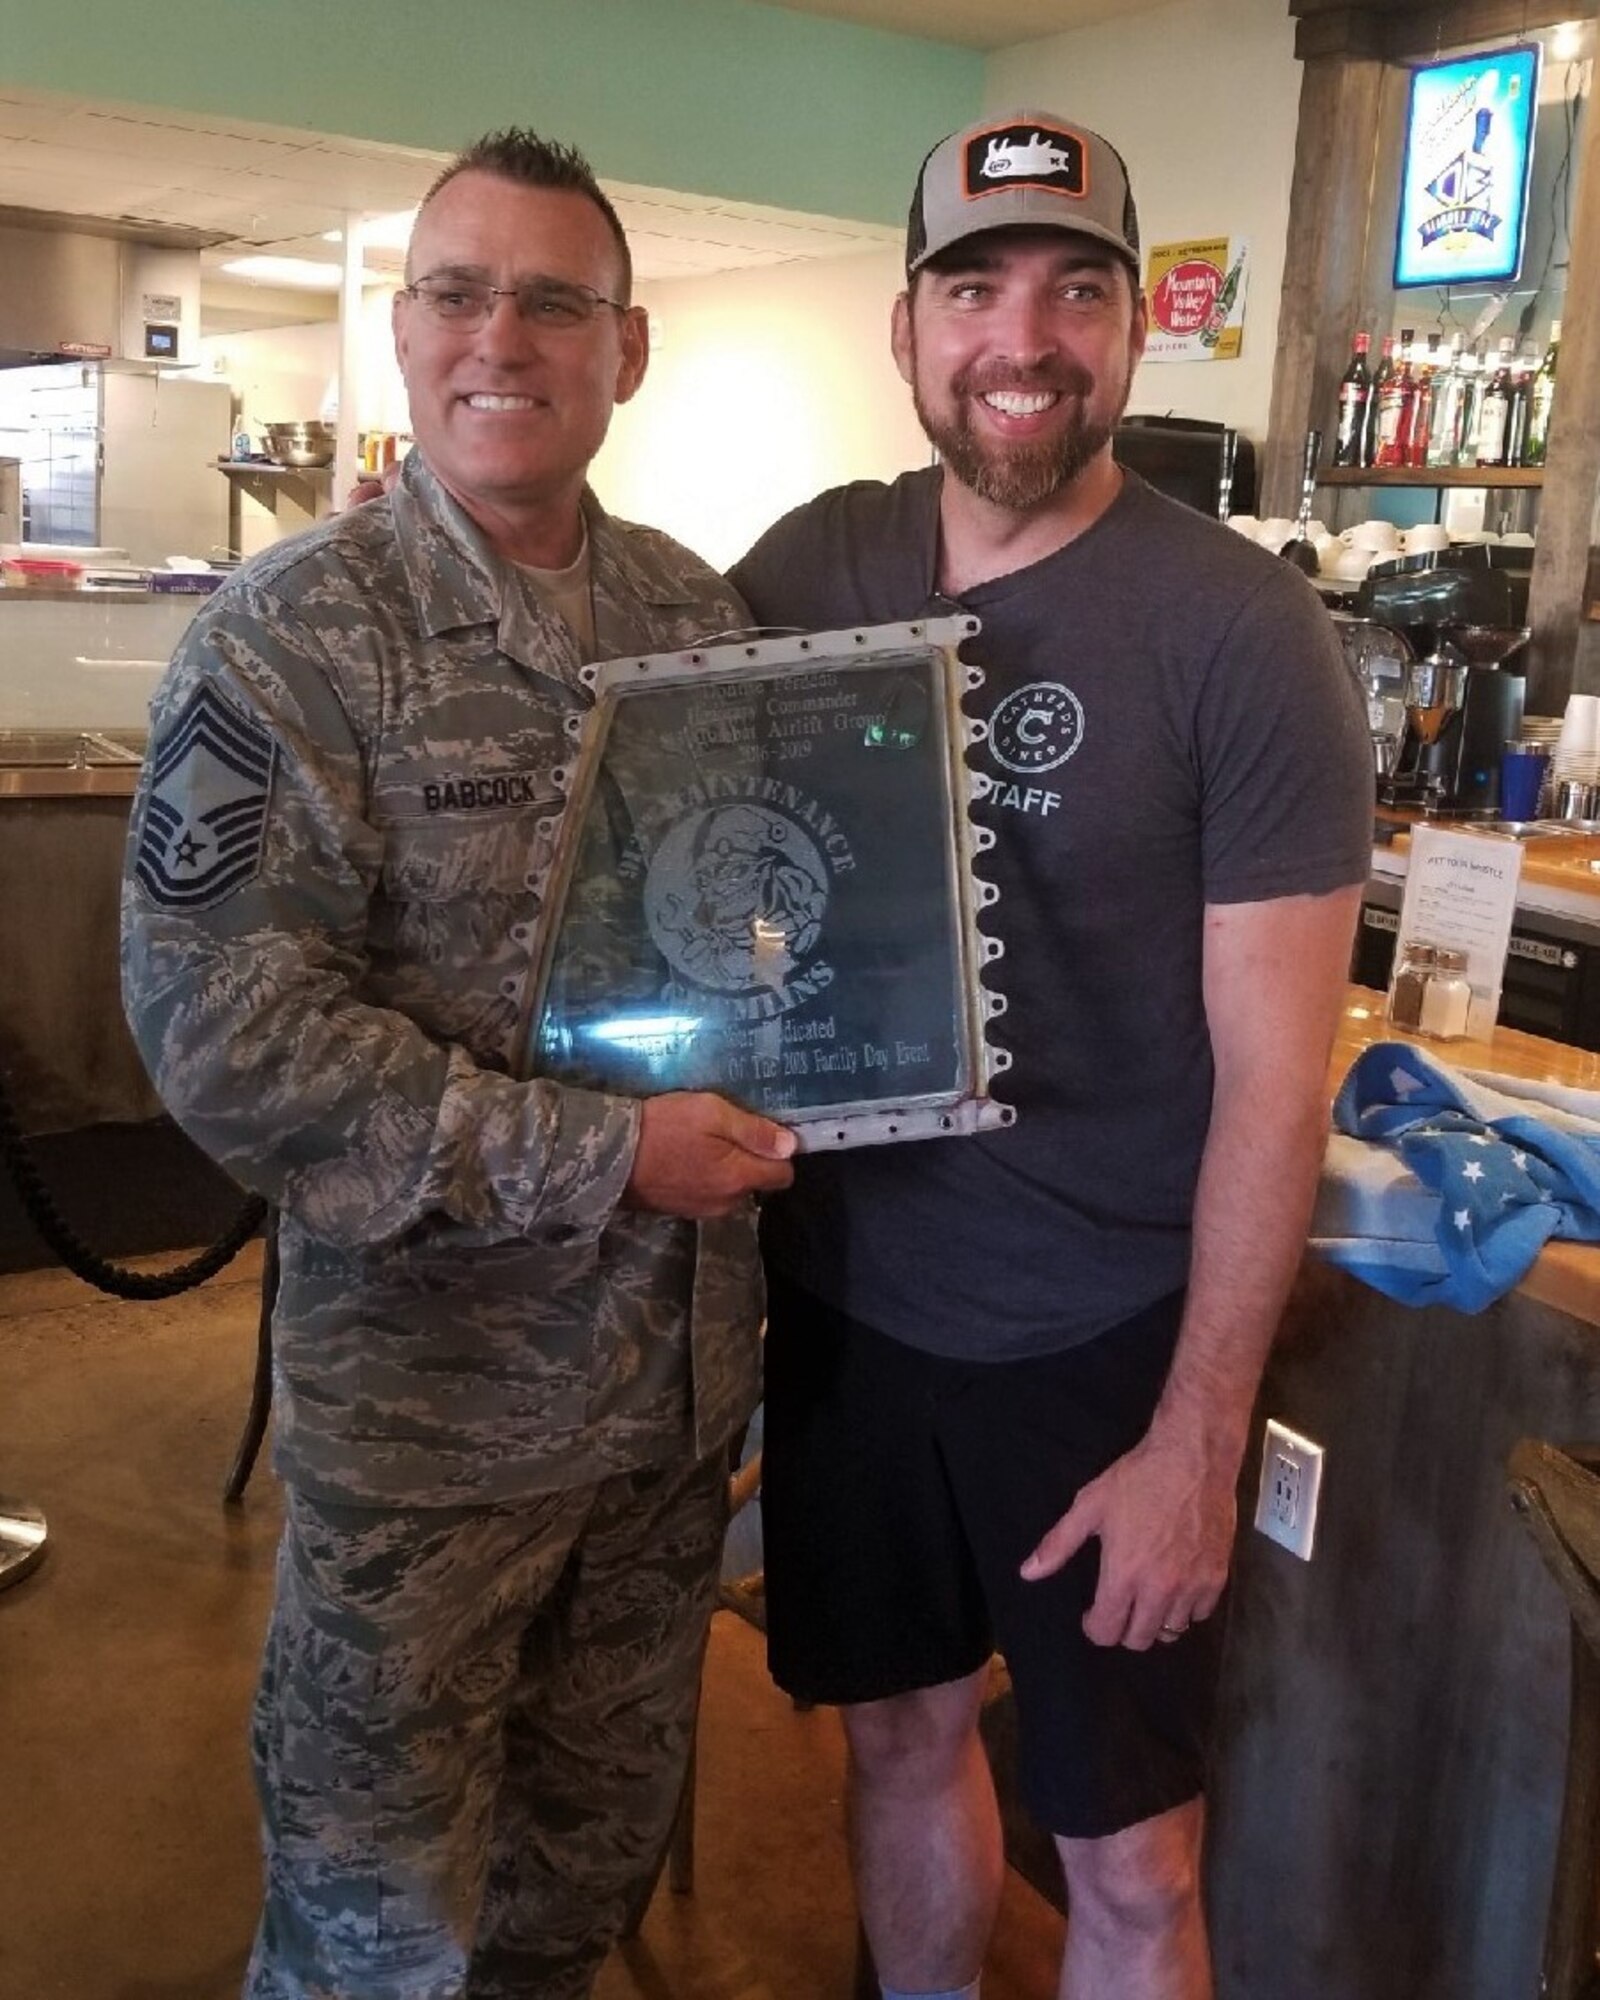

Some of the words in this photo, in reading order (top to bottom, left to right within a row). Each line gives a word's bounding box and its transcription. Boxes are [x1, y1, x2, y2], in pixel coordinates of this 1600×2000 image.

[1163, 272, 1217, 302] Mountain
[1172, 291, 1209, 312] Valley
[1170, 310, 1202, 327] Water
[766, 691, 857, 717] Commander
[1001, 692, 1074, 735] CATHEAD'S
[767, 714, 823, 739] Airlift
[833, 710, 887, 732] Group
[1001, 736, 1057, 761] DINER
[423, 775, 537, 812] BABCOCK
[989, 780, 1062, 817] TAFF
[814, 1047, 857, 1074] Family
[863, 1042, 889, 1071] Day
